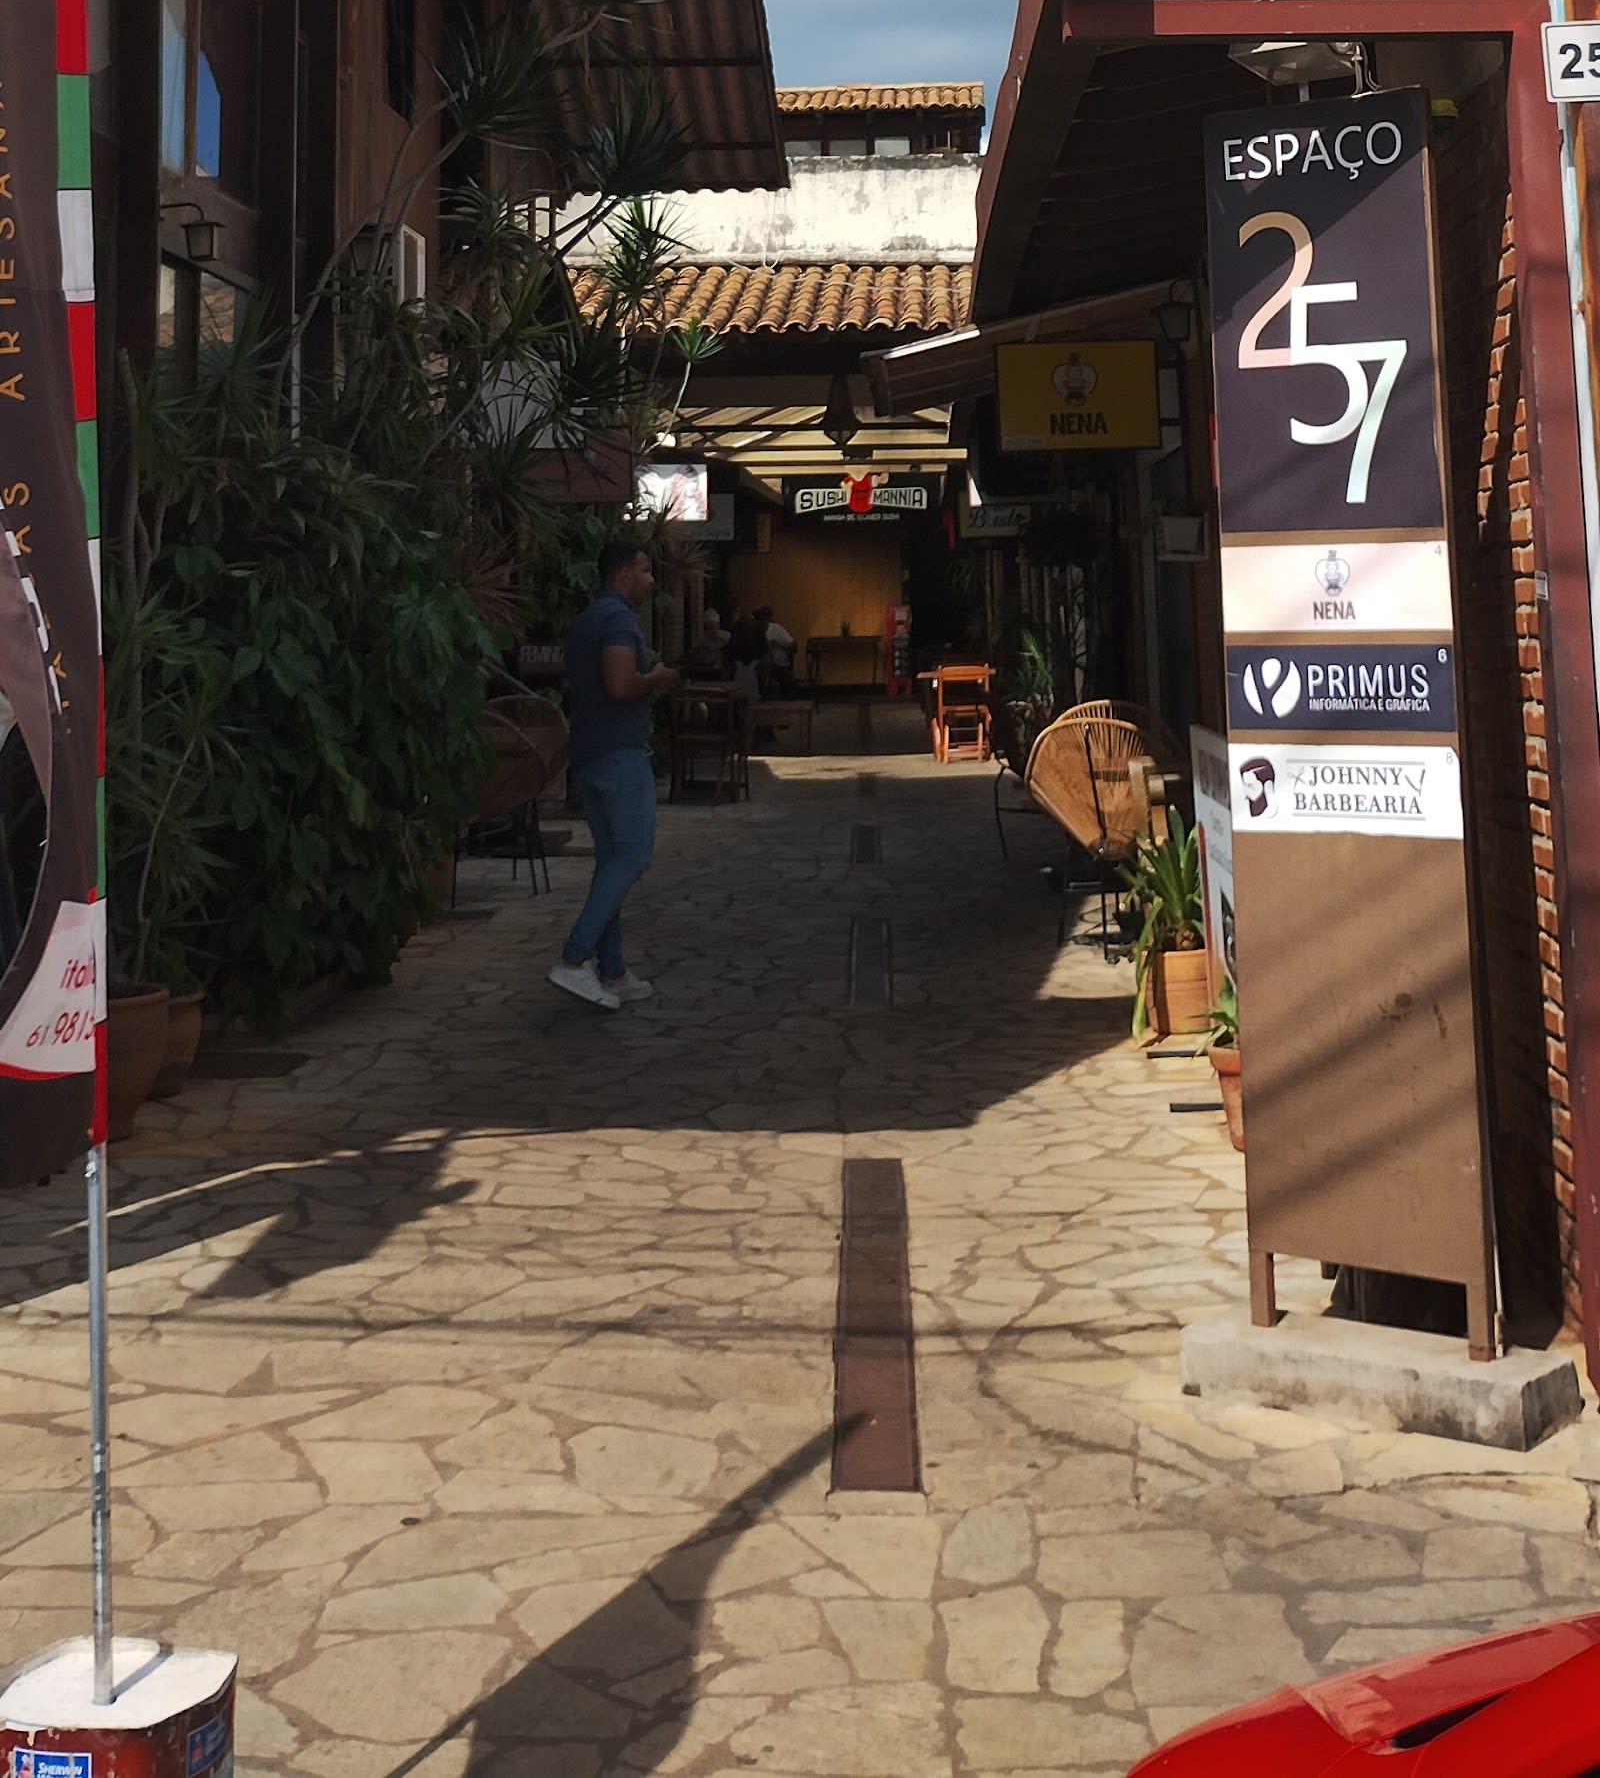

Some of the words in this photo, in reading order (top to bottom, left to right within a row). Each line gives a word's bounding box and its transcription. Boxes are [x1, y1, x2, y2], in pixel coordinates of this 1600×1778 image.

[1222, 121, 1402, 181] ESPAÇO
[1238, 210, 1408, 505] 257
[1050, 411, 1108, 435] NENA
[1312, 600, 1356, 621] NENA
[1437, 648, 1448, 663] 6
[1307, 663, 1430, 699] PRIMUS
[1309, 696, 1377, 711] INFORMÁTICA
[1385, 696, 1431, 712] GRÁFICA
[1308, 765, 1403, 787] JOHNNY
[1293, 792, 1423, 814] BARBEARIA
